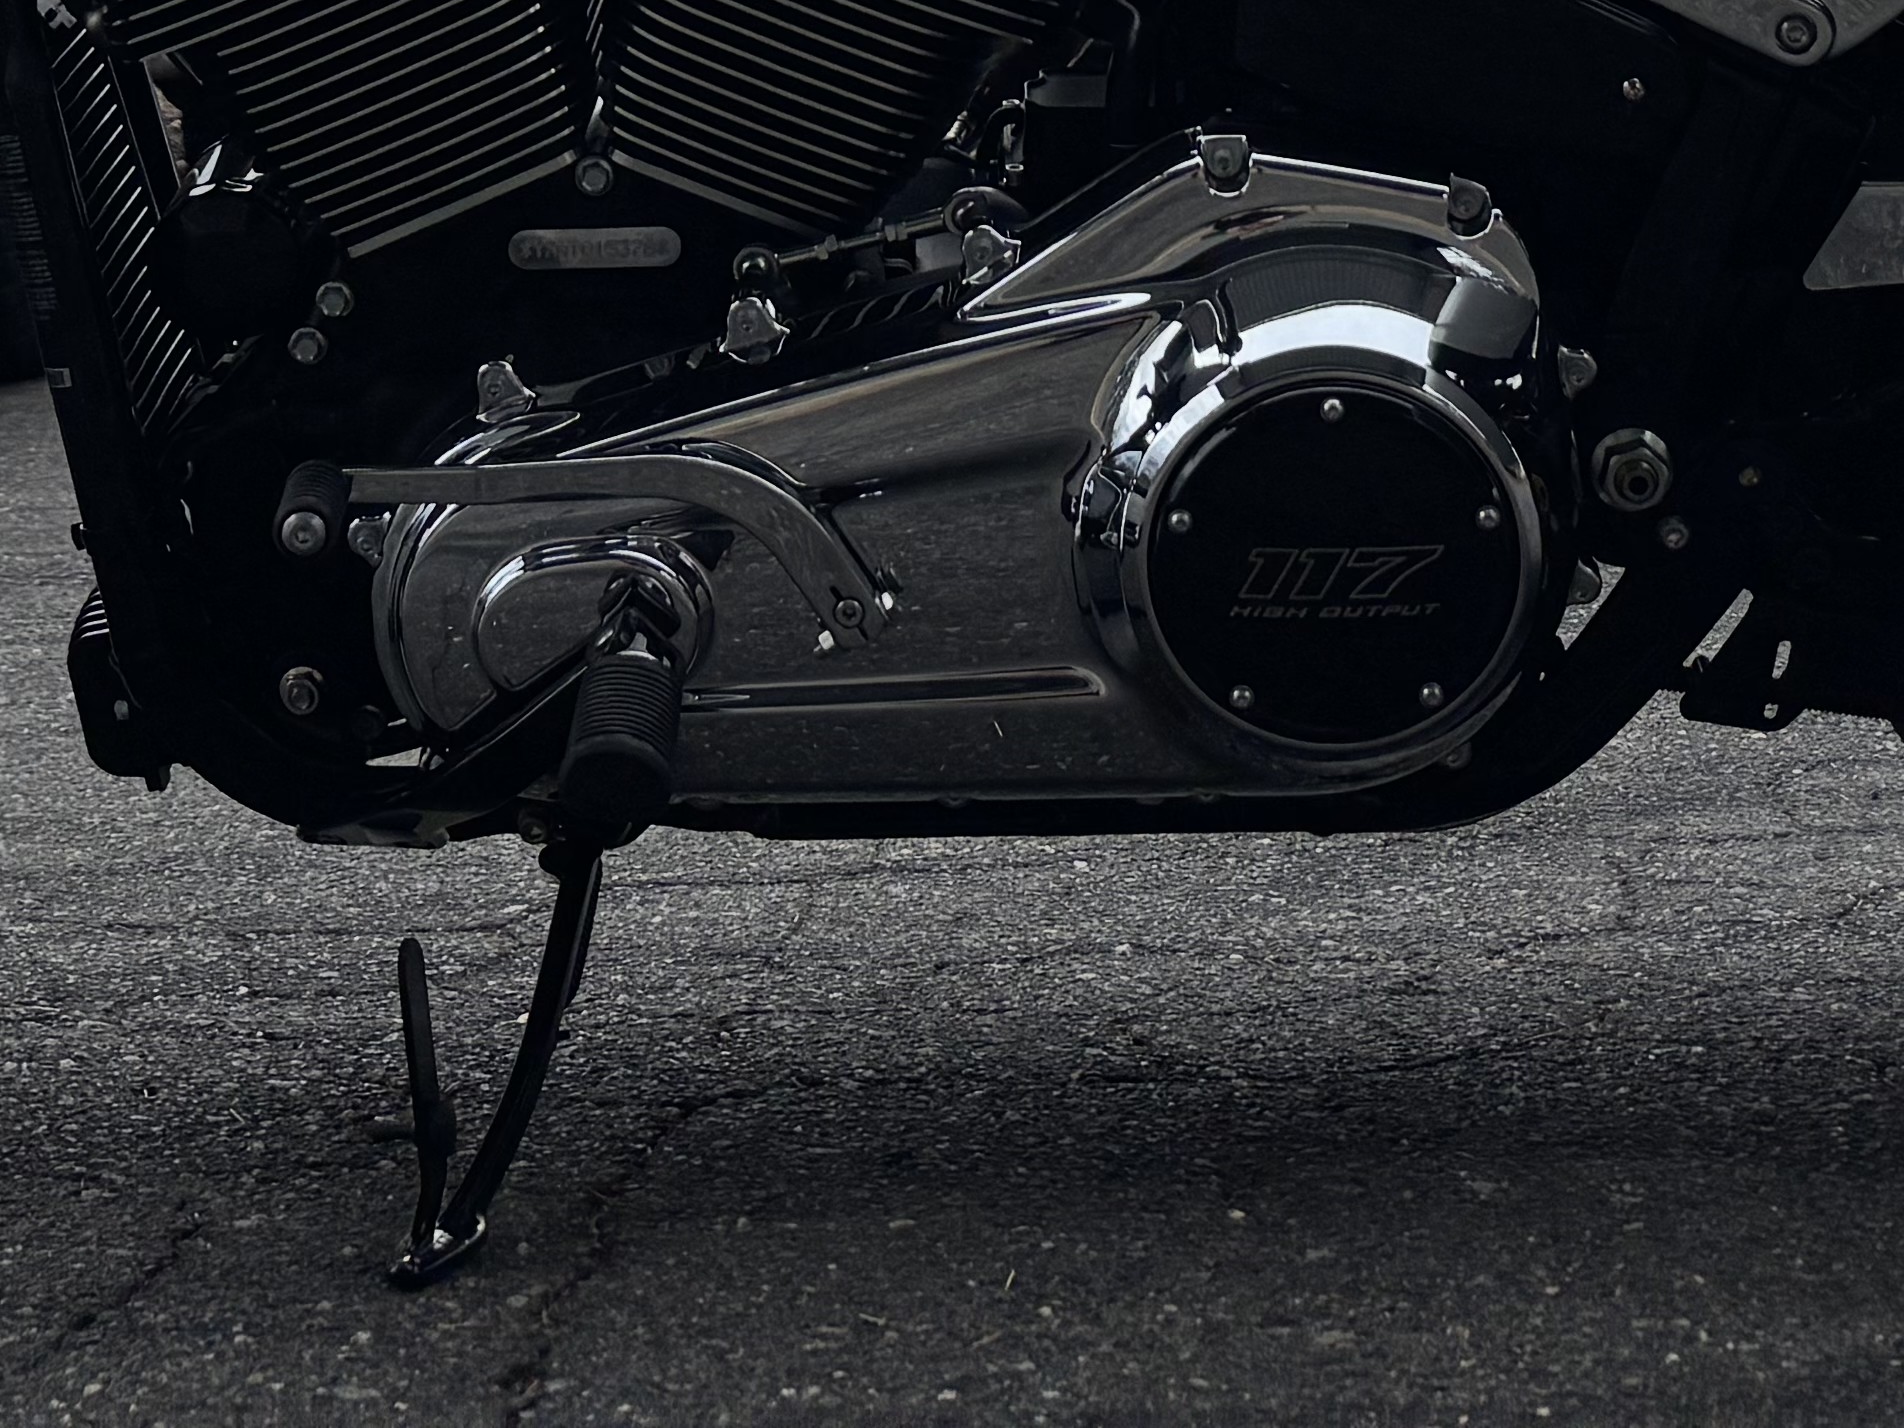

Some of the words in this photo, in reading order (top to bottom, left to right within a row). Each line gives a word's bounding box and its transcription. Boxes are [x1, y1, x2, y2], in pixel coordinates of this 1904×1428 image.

[1238, 545, 1445, 599] 117
[1229, 604, 1306, 618] HIGH
[1318, 603, 1441, 618] OUTPUT
